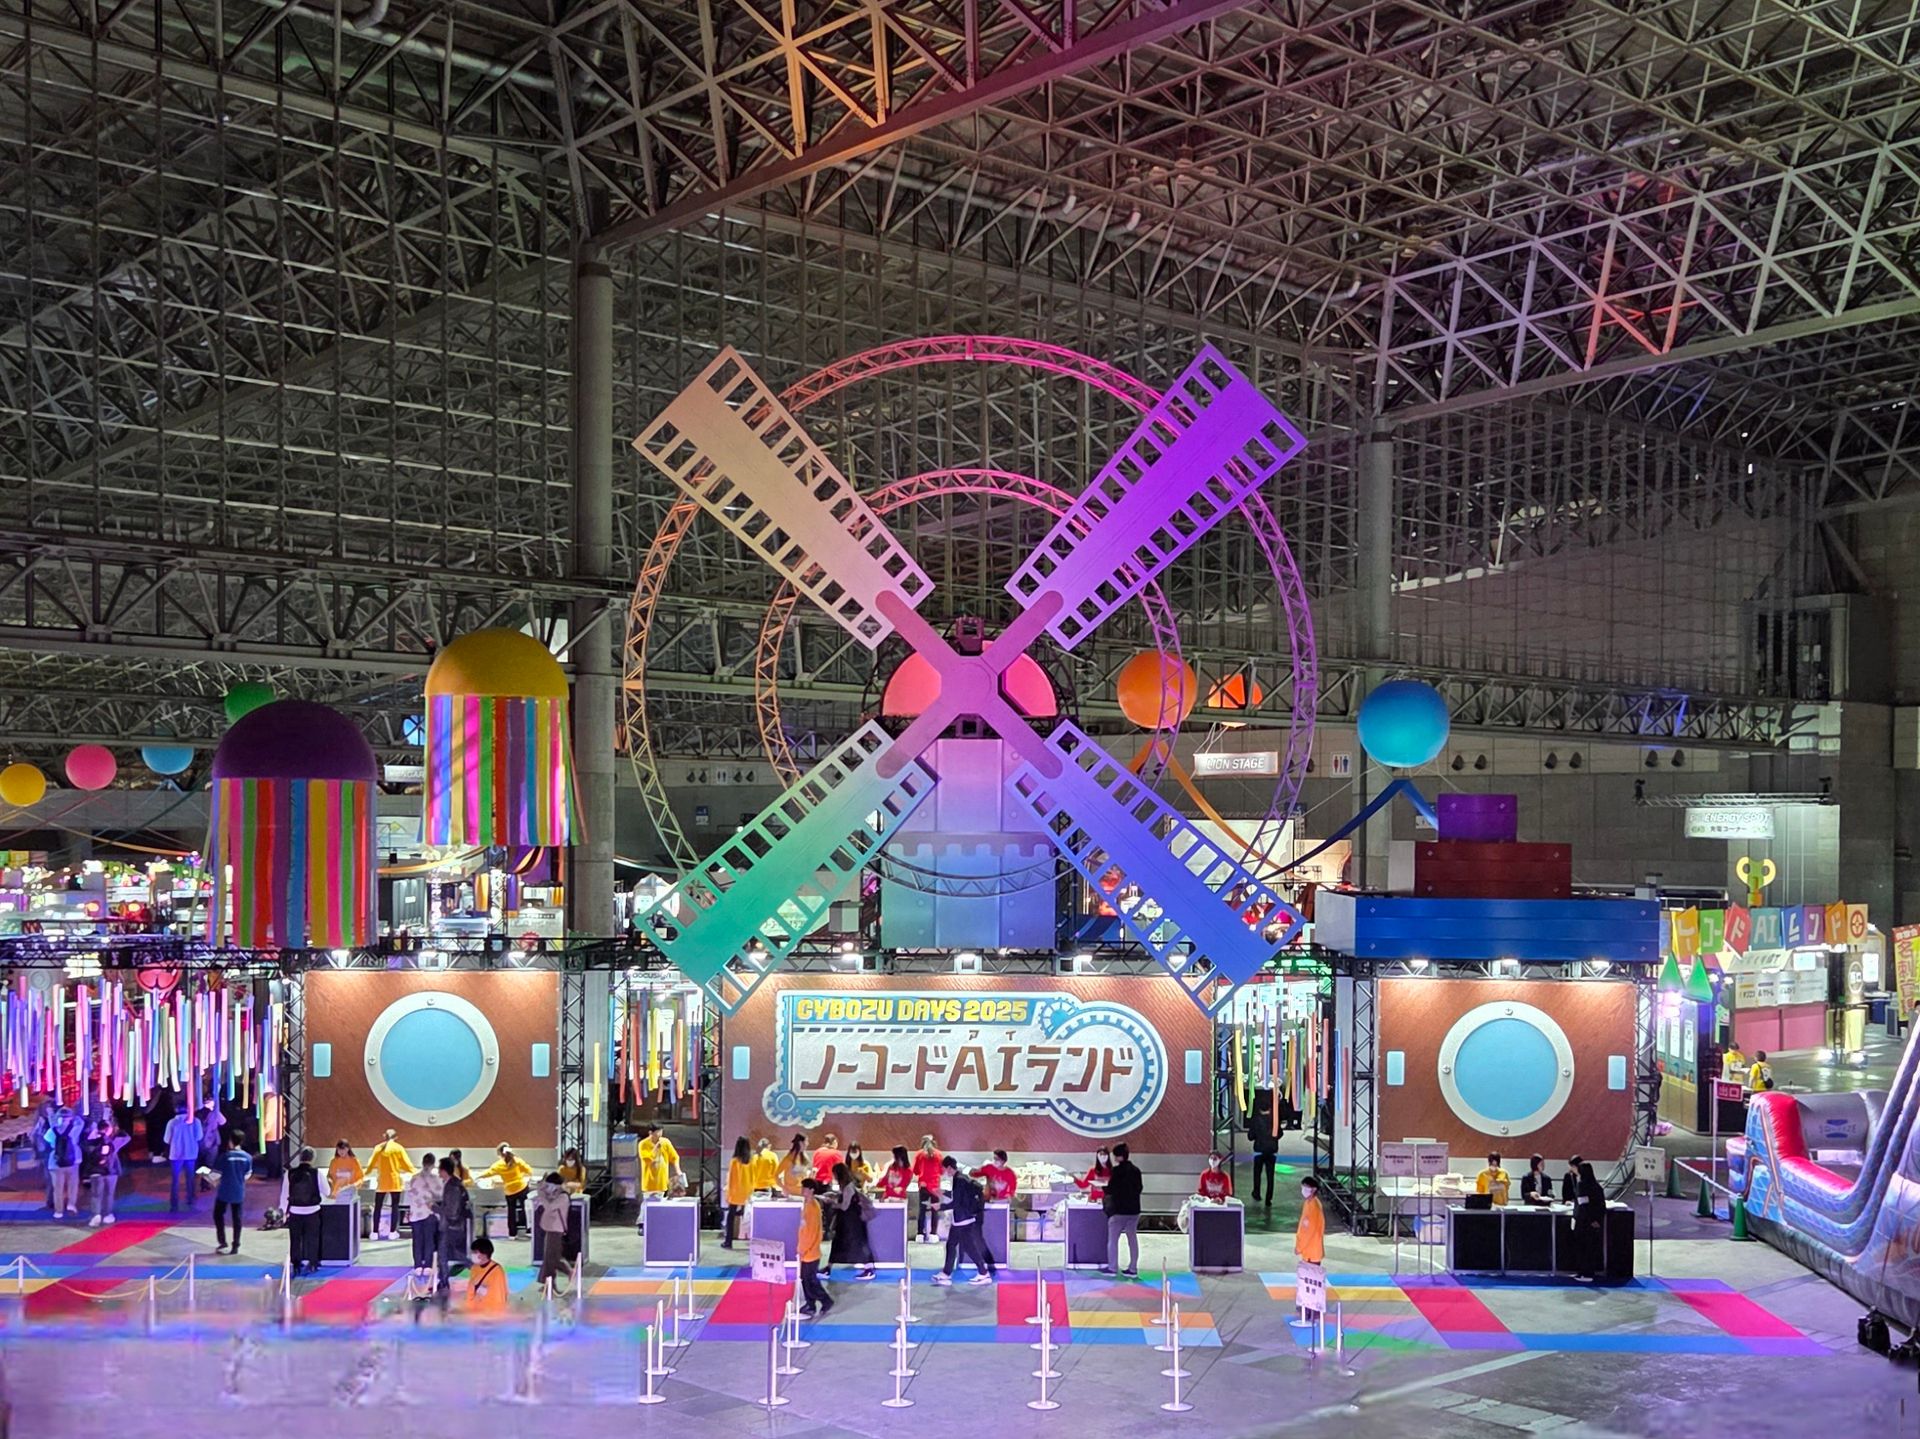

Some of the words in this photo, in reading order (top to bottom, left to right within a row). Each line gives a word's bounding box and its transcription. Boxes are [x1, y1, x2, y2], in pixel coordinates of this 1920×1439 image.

[1231, 757, 1265, 770] STAGE
[1704, 812, 1742, 823] ENERGY
[796, 999, 894, 1021] CYBOZU
[899, 999, 961, 1022] DAYS
[963, 1000, 1028, 1022] 2025
[800, 1043, 1134, 1093] ノーコードAIランド
[1719, 1084, 1740, 1098] 出口
